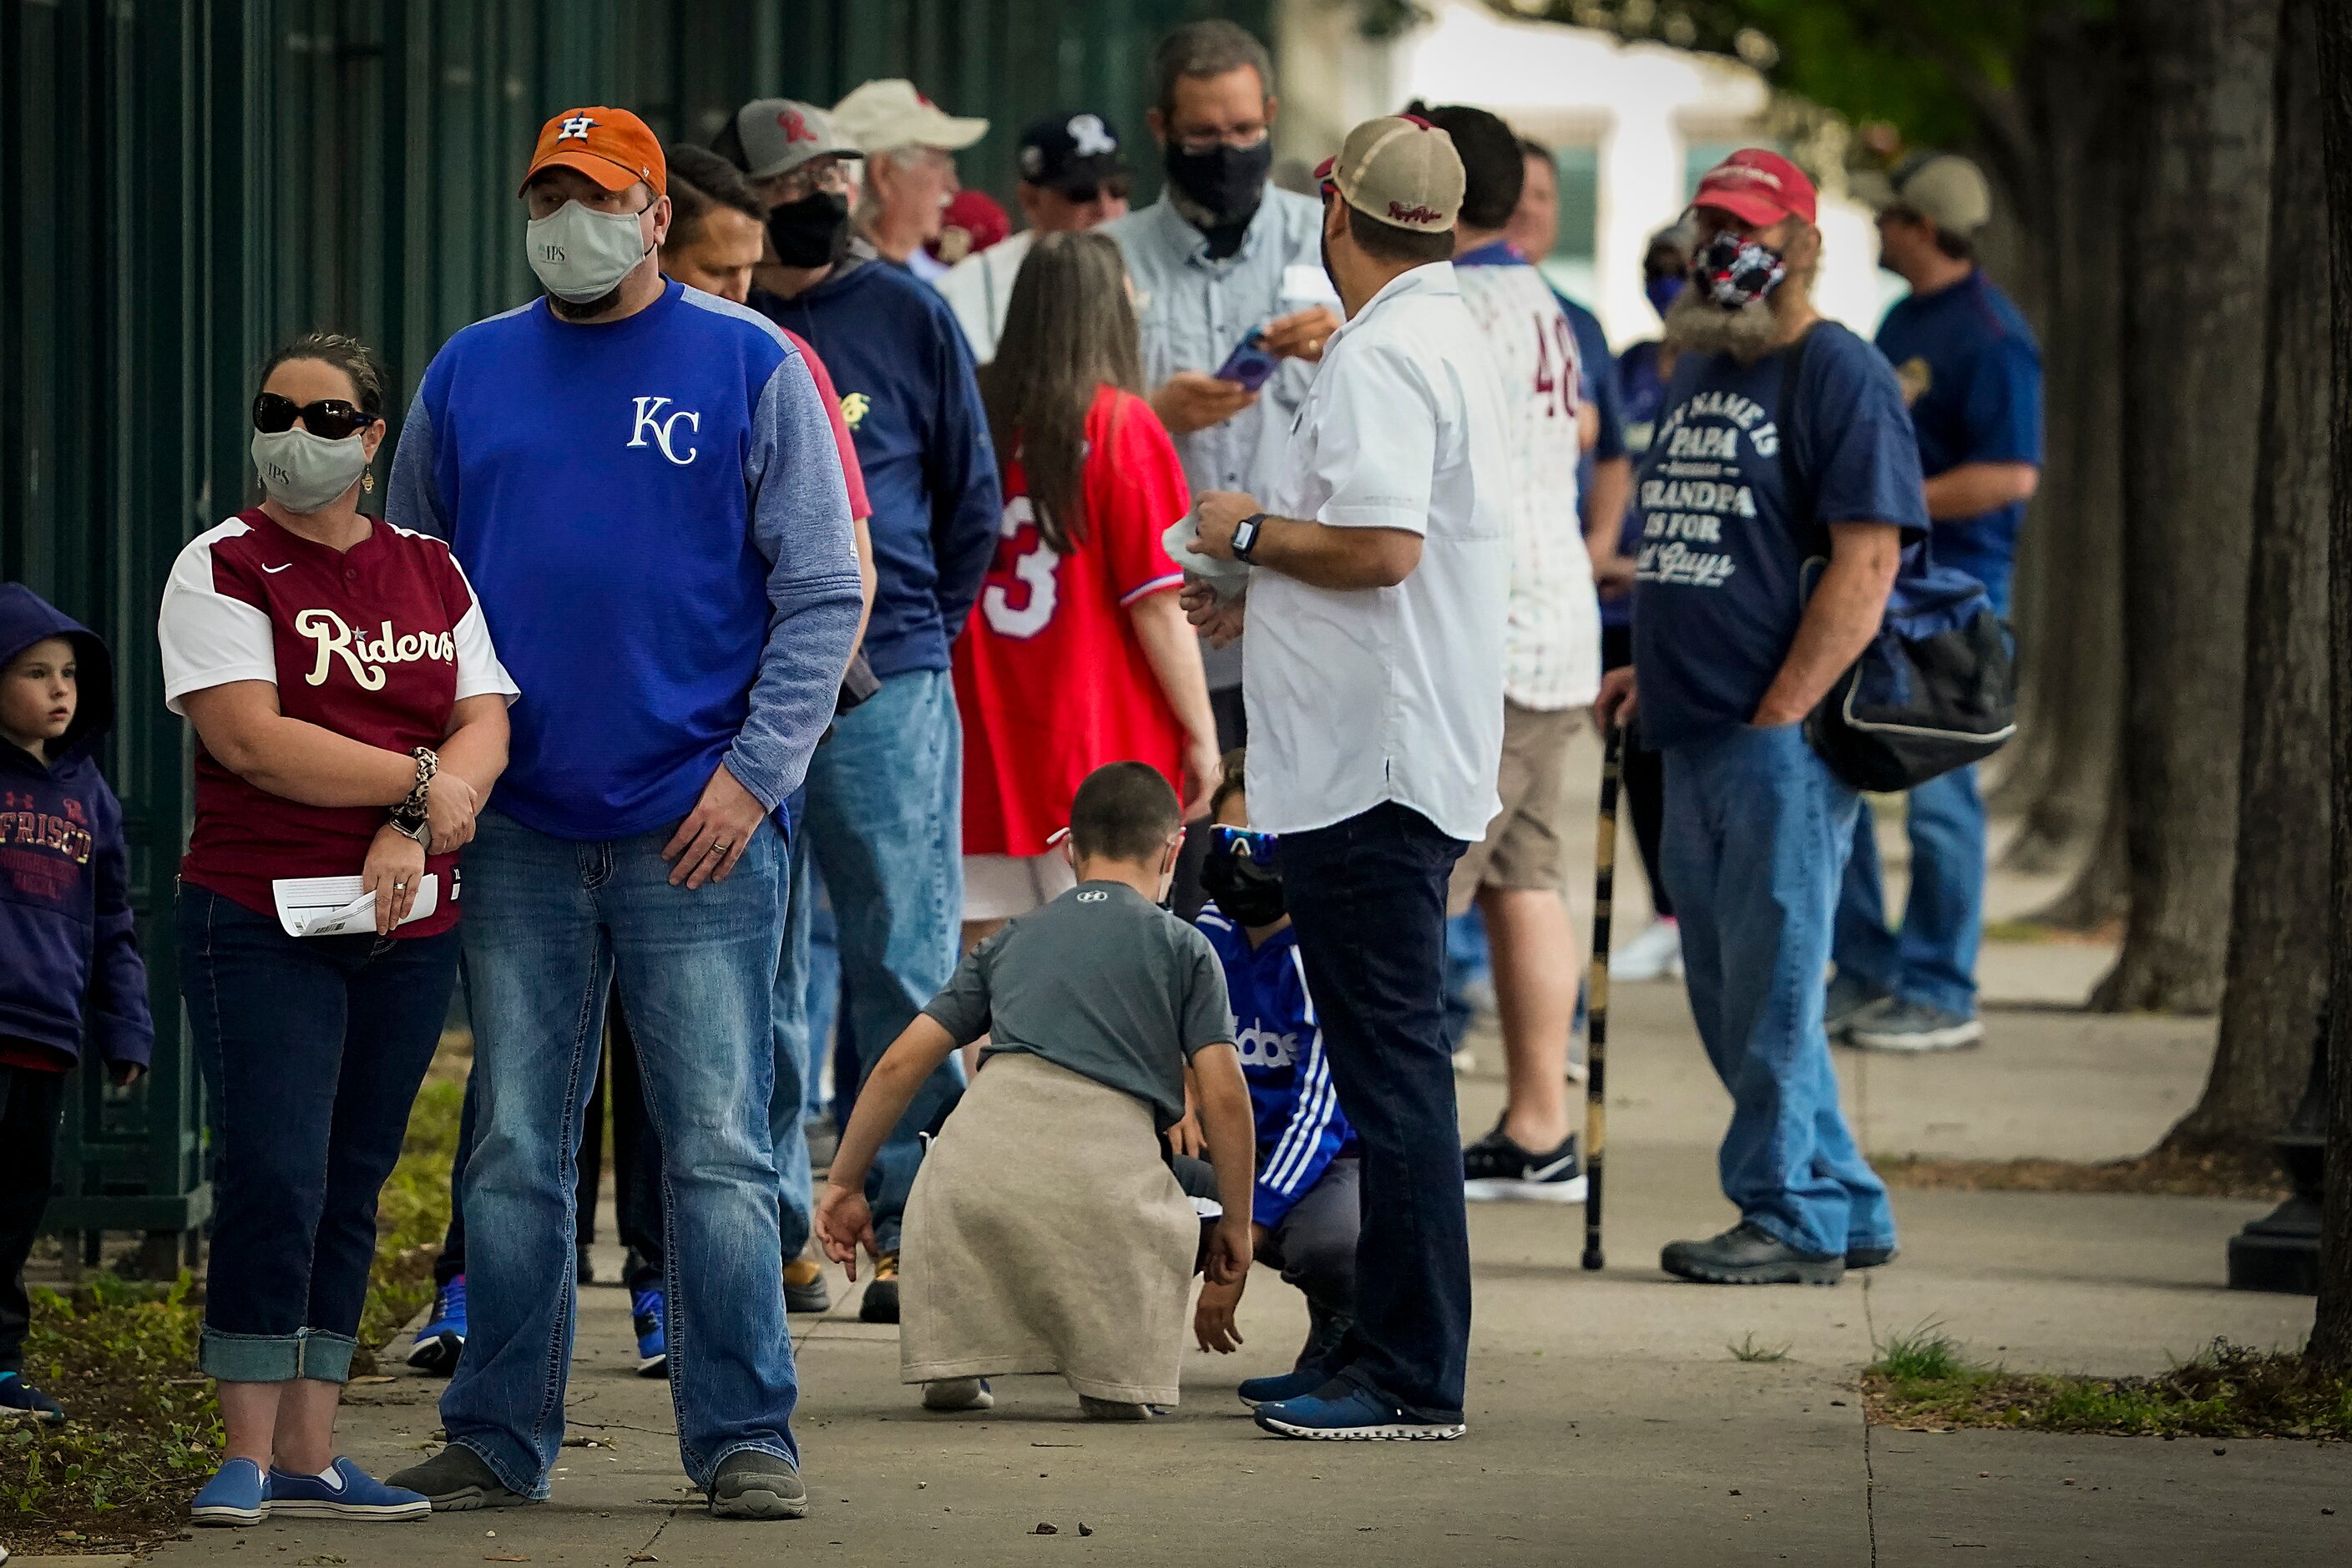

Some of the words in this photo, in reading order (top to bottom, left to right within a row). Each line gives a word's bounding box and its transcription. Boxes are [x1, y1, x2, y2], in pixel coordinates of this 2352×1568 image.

[557, 117, 595, 139] H
[625, 396, 701, 466] KC
[1667, 427, 1739, 459] PAPA
[1689, 390, 1766, 431] NAME
[1748, 421, 1781, 458] IS
[1665, 513, 1722, 543] FOR
[981, 496, 1060, 640] 3
[295, 609, 455, 691] Riders
[0, 812, 93, 864] FRISCO
